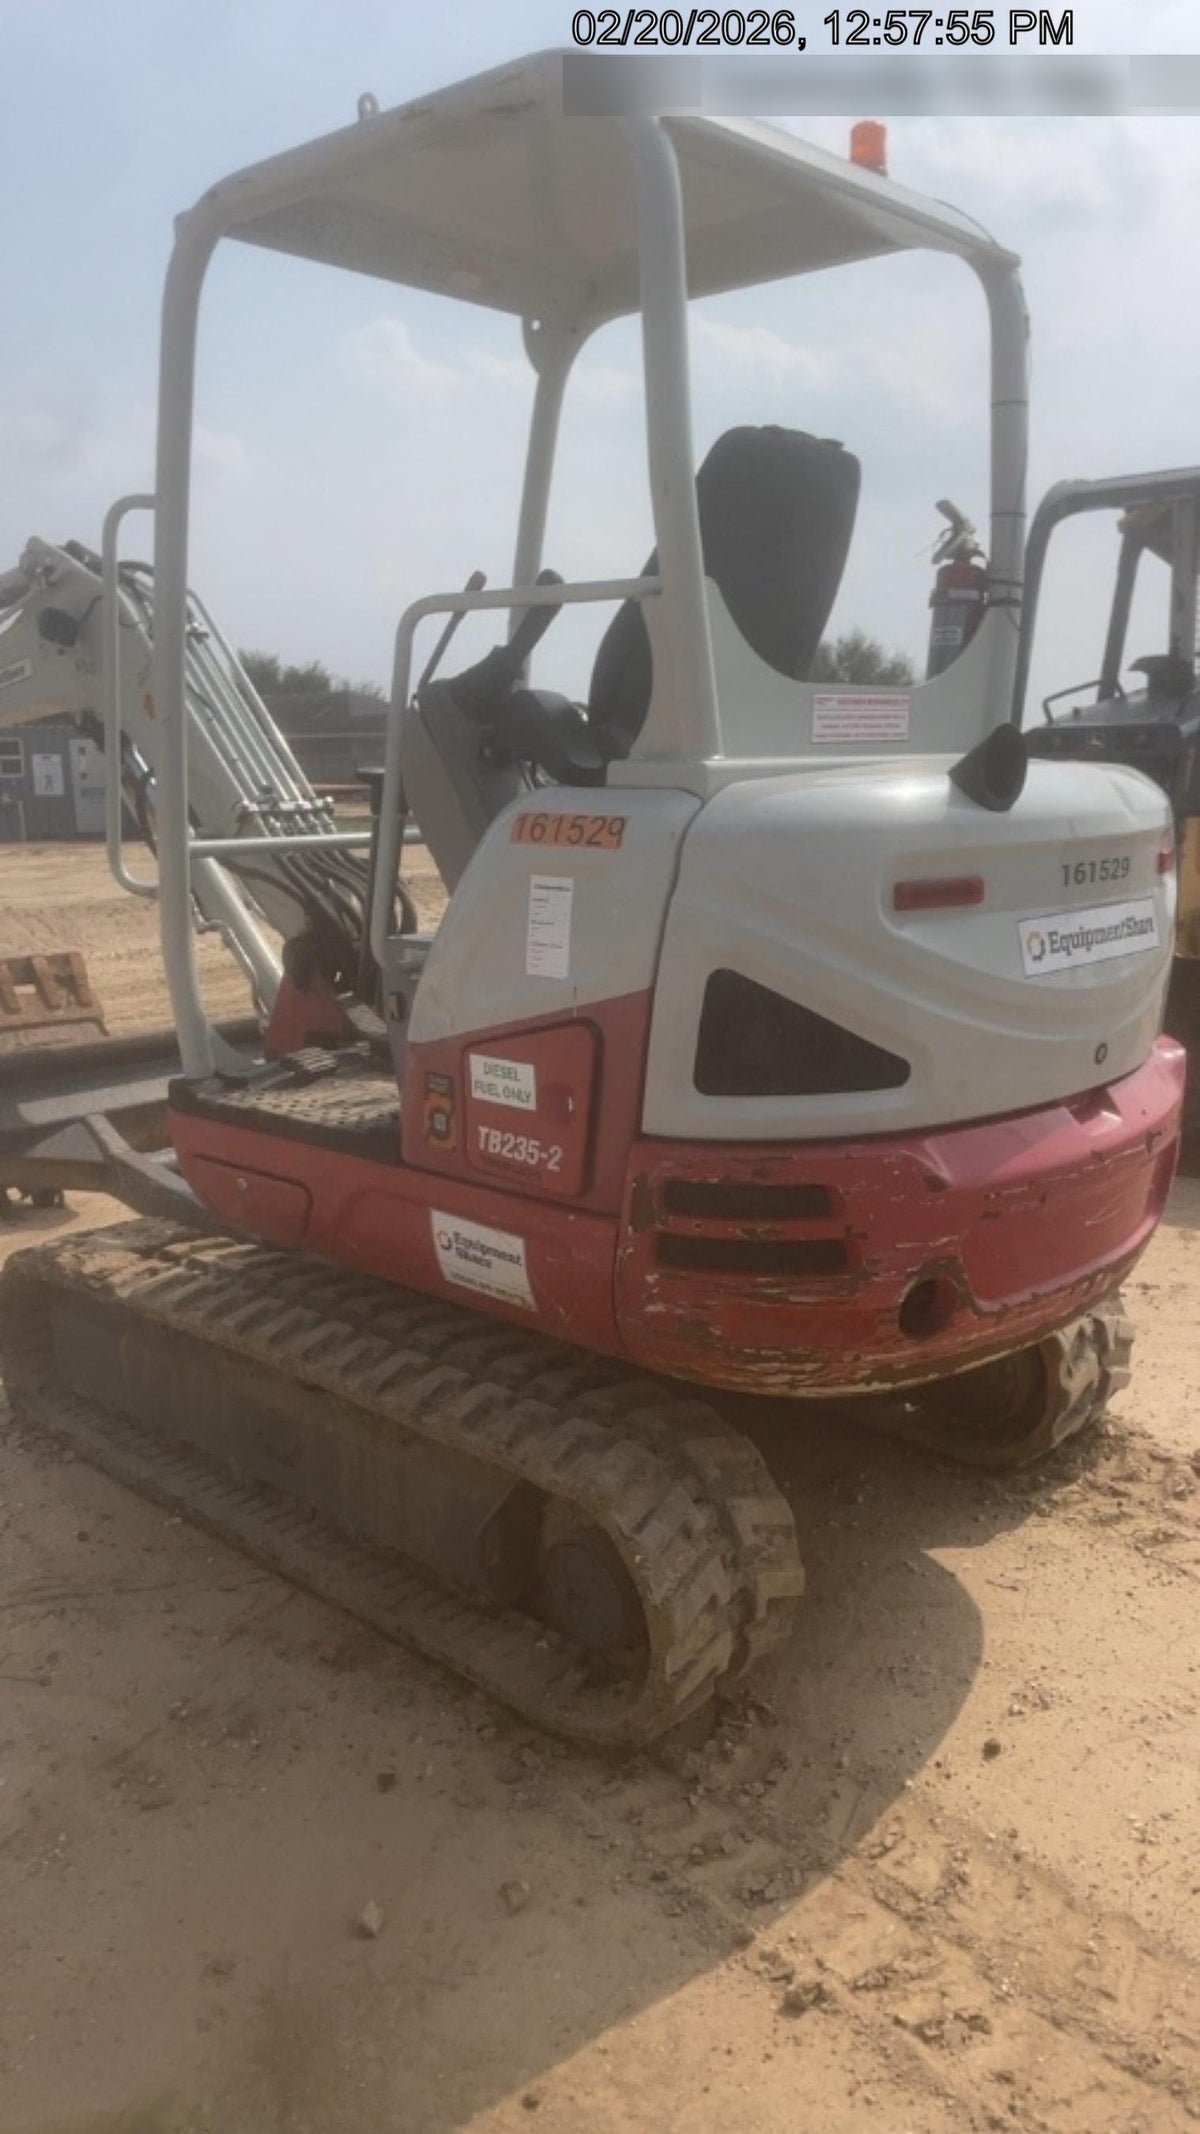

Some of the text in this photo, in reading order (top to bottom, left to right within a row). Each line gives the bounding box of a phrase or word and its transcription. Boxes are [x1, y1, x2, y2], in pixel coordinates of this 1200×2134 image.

[516, 813, 626, 848] 161529
[1062, 857, 1130, 886] 161529
[483, 1062, 520, 1082] DIESEL
[474, 1080, 532, 1104] FUEL ONLY
[477, 1125, 563, 1171] TB235-2
